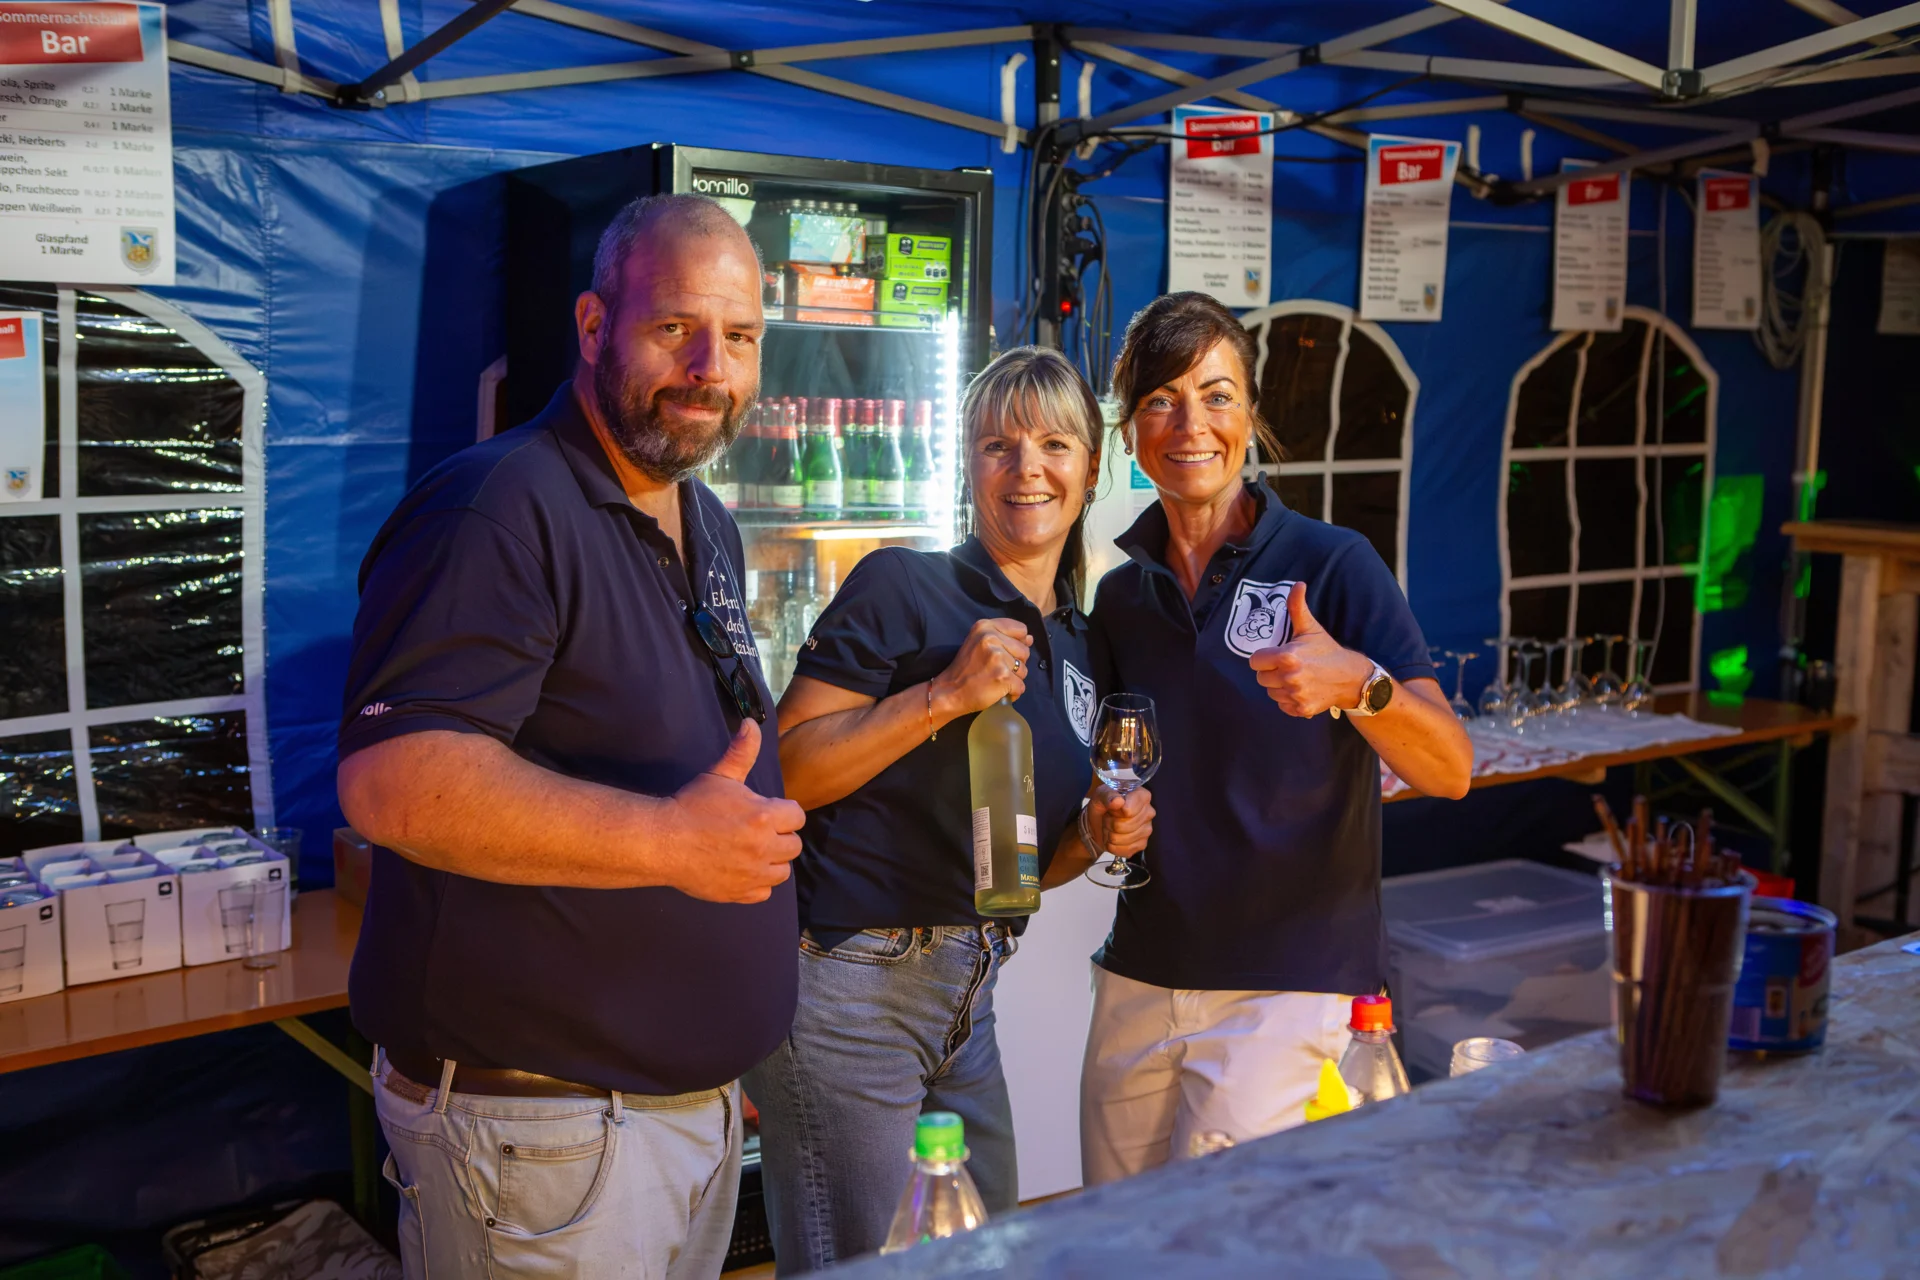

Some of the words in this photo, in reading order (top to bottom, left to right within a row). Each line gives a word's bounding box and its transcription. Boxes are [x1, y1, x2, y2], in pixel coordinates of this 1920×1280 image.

[0, 11, 127, 25] ommernachtsball
[40, 30, 91, 54] Bar
[23, 79, 56, 91] Sprite
[118, 87, 153, 99] Marke
[29, 94, 68, 108] Orange
[119, 102, 153, 114] Marke
[120, 121, 155, 134] Marke
[44, 166, 69, 178] Sekt
[1397, 161, 1423, 181] Bar
[15, 183, 80, 196] Fruchtsecco
[28, 202, 83, 214] Weißwein
[35, 233, 89, 245] Glaspfand
[49, 245, 84, 256] Marke
